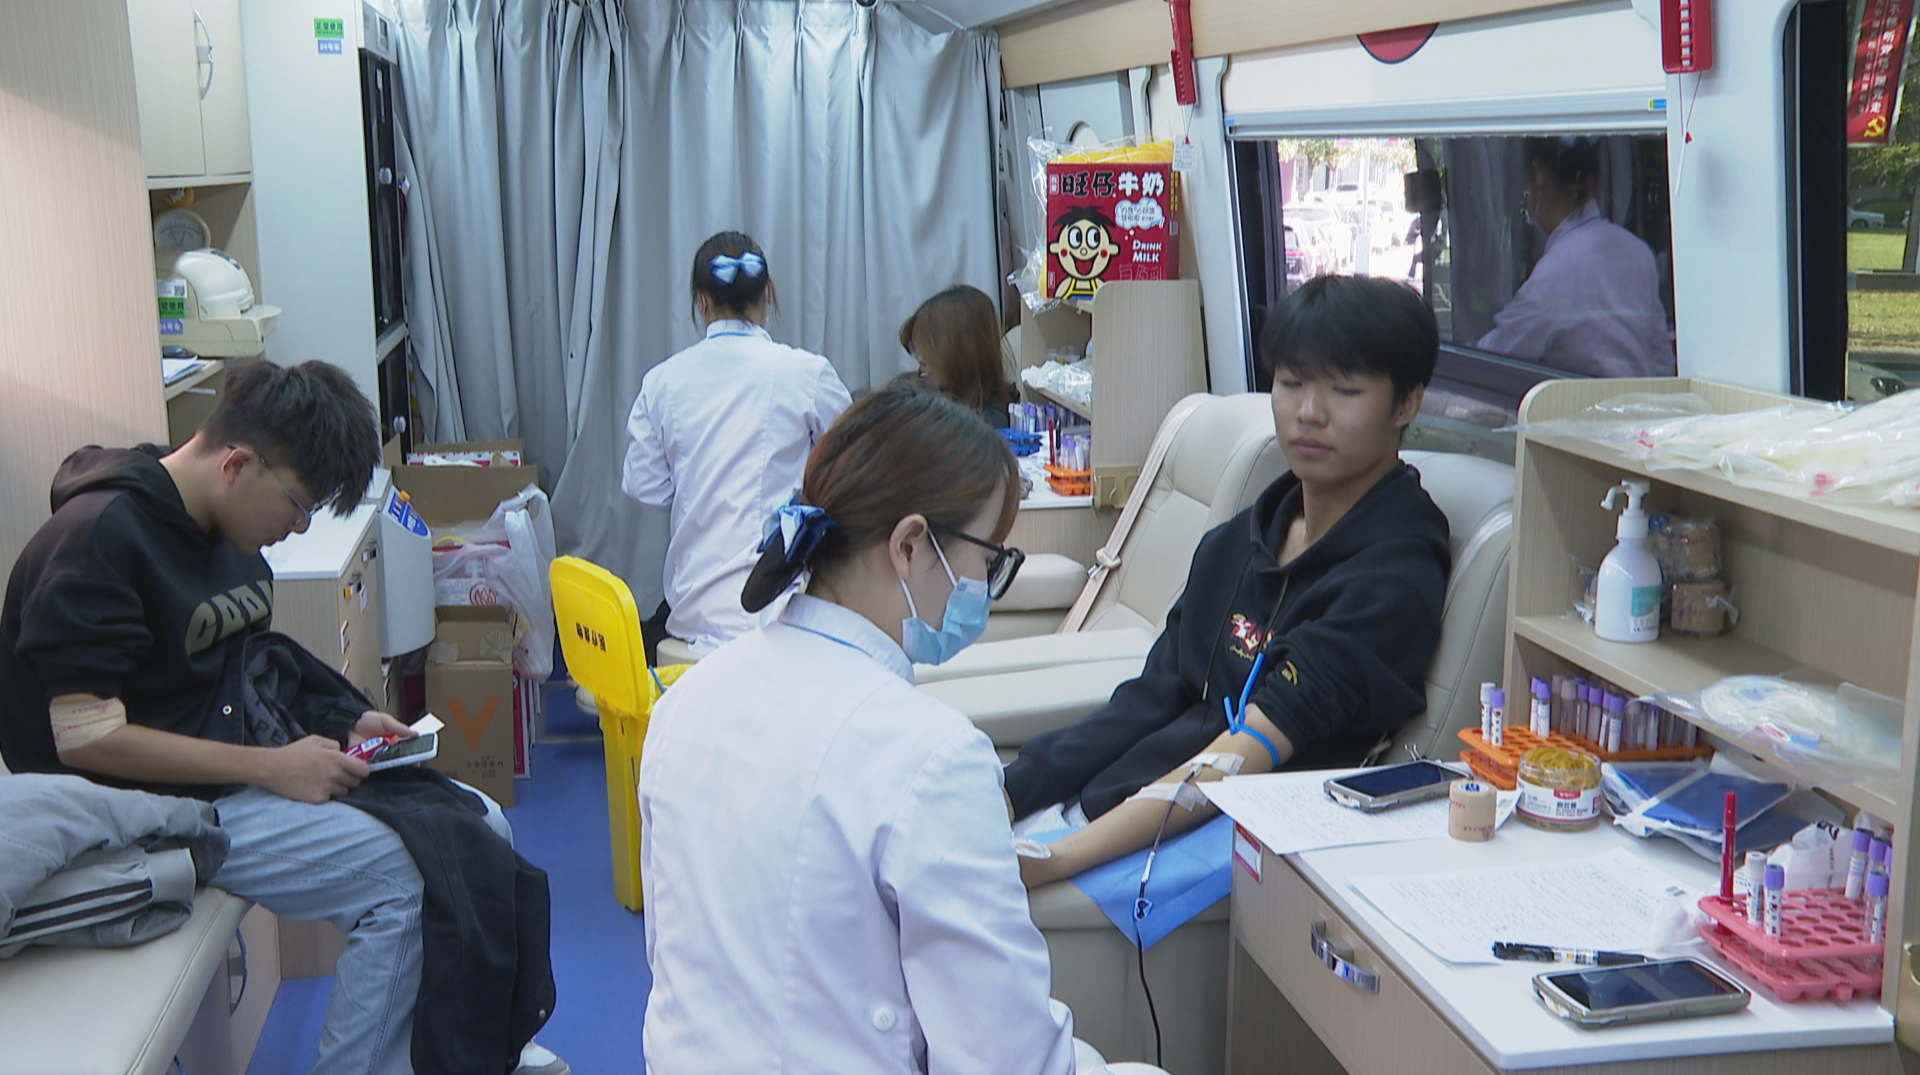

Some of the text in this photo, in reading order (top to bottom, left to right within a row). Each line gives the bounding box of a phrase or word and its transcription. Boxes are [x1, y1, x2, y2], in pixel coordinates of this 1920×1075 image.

[1061, 170, 1165, 198] 旺仔牛奶
[1132, 239, 1162, 251] DRINK
[1132, 252, 1160, 263] MILK
